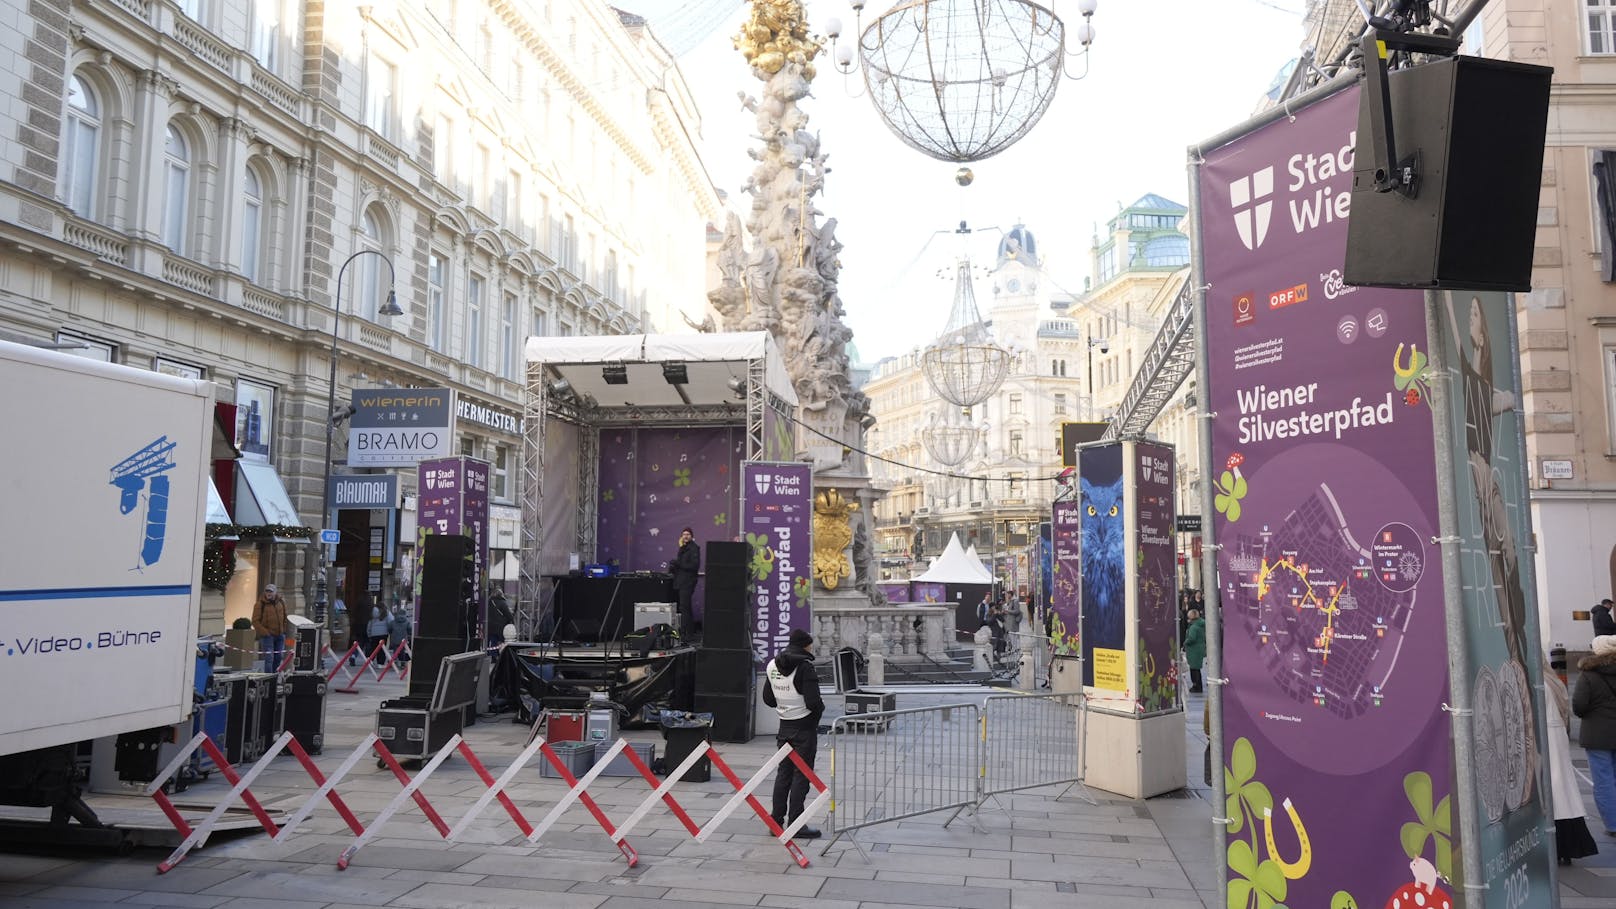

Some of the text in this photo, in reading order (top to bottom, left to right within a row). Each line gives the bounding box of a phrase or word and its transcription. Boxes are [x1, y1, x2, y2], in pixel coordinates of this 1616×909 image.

[1287, 131, 1357, 192] Stad
[1288, 186, 1352, 234] Wie
[1271, 291, 1294, 306] ORF
[360, 396, 441, 408] wienerin
[1236, 382, 1318, 415] Wiener
[1238, 392, 1394, 444] Silvesterpfad
[357, 432, 438, 450] BRAMO
[1153, 458, 1169, 472] Stadt
[437, 469, 455, 479] Stadt
[774, 474, 800, 485] Stadt
[1153, 471, 1169, 485] Wien
[437, 479, 455, 489] Wien
[774, 485, 800, 495] Wien
[15, 630, 162, 655] Video Bühne
[1503, 863, 1530, 909] 2025
